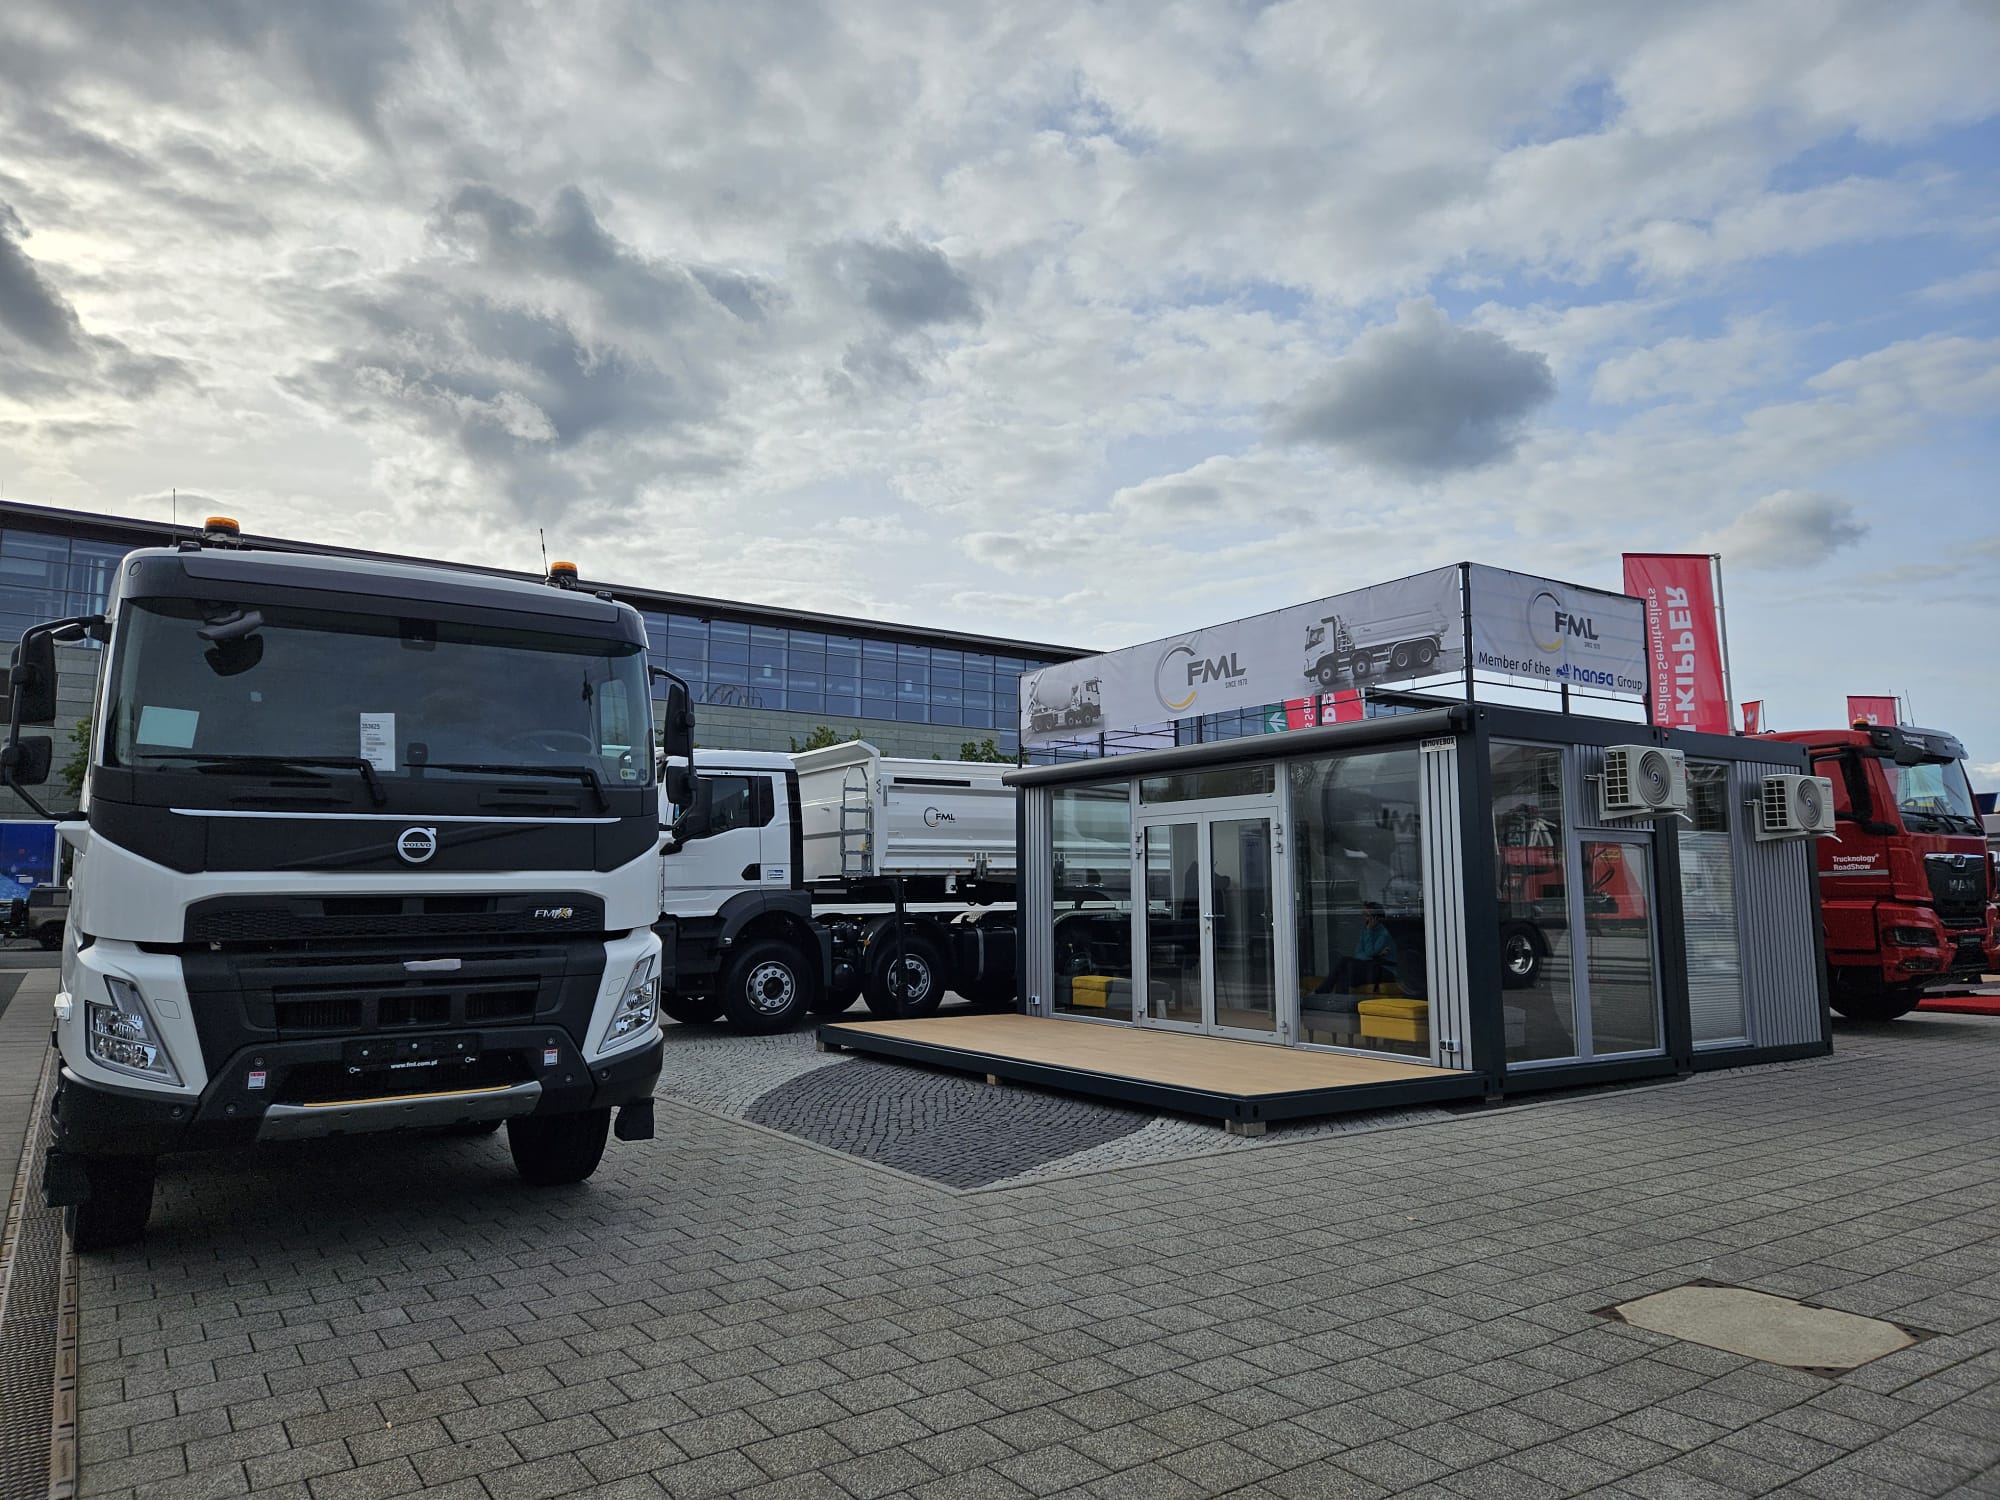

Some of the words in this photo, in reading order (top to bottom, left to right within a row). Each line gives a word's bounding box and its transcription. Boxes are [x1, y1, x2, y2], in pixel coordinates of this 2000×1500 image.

[1555, 611, 1599, 641] FML
[1187, 652, 1247, 687] FML
[1478, 651, 1519, 671] Member
[1522, 658, 1533, 673] of
[1534, 661, 1551, 676] the
[1573, 664, 1614, 687] hansa
[1617, 675, 1643, 691] Group
[1225, 680, 1236, 689] SINCE
[935, 813, 956, 821] FML
[1833, 863, 1871, 871] RoadShow
[1948, 879, 1976, 891] MAN
